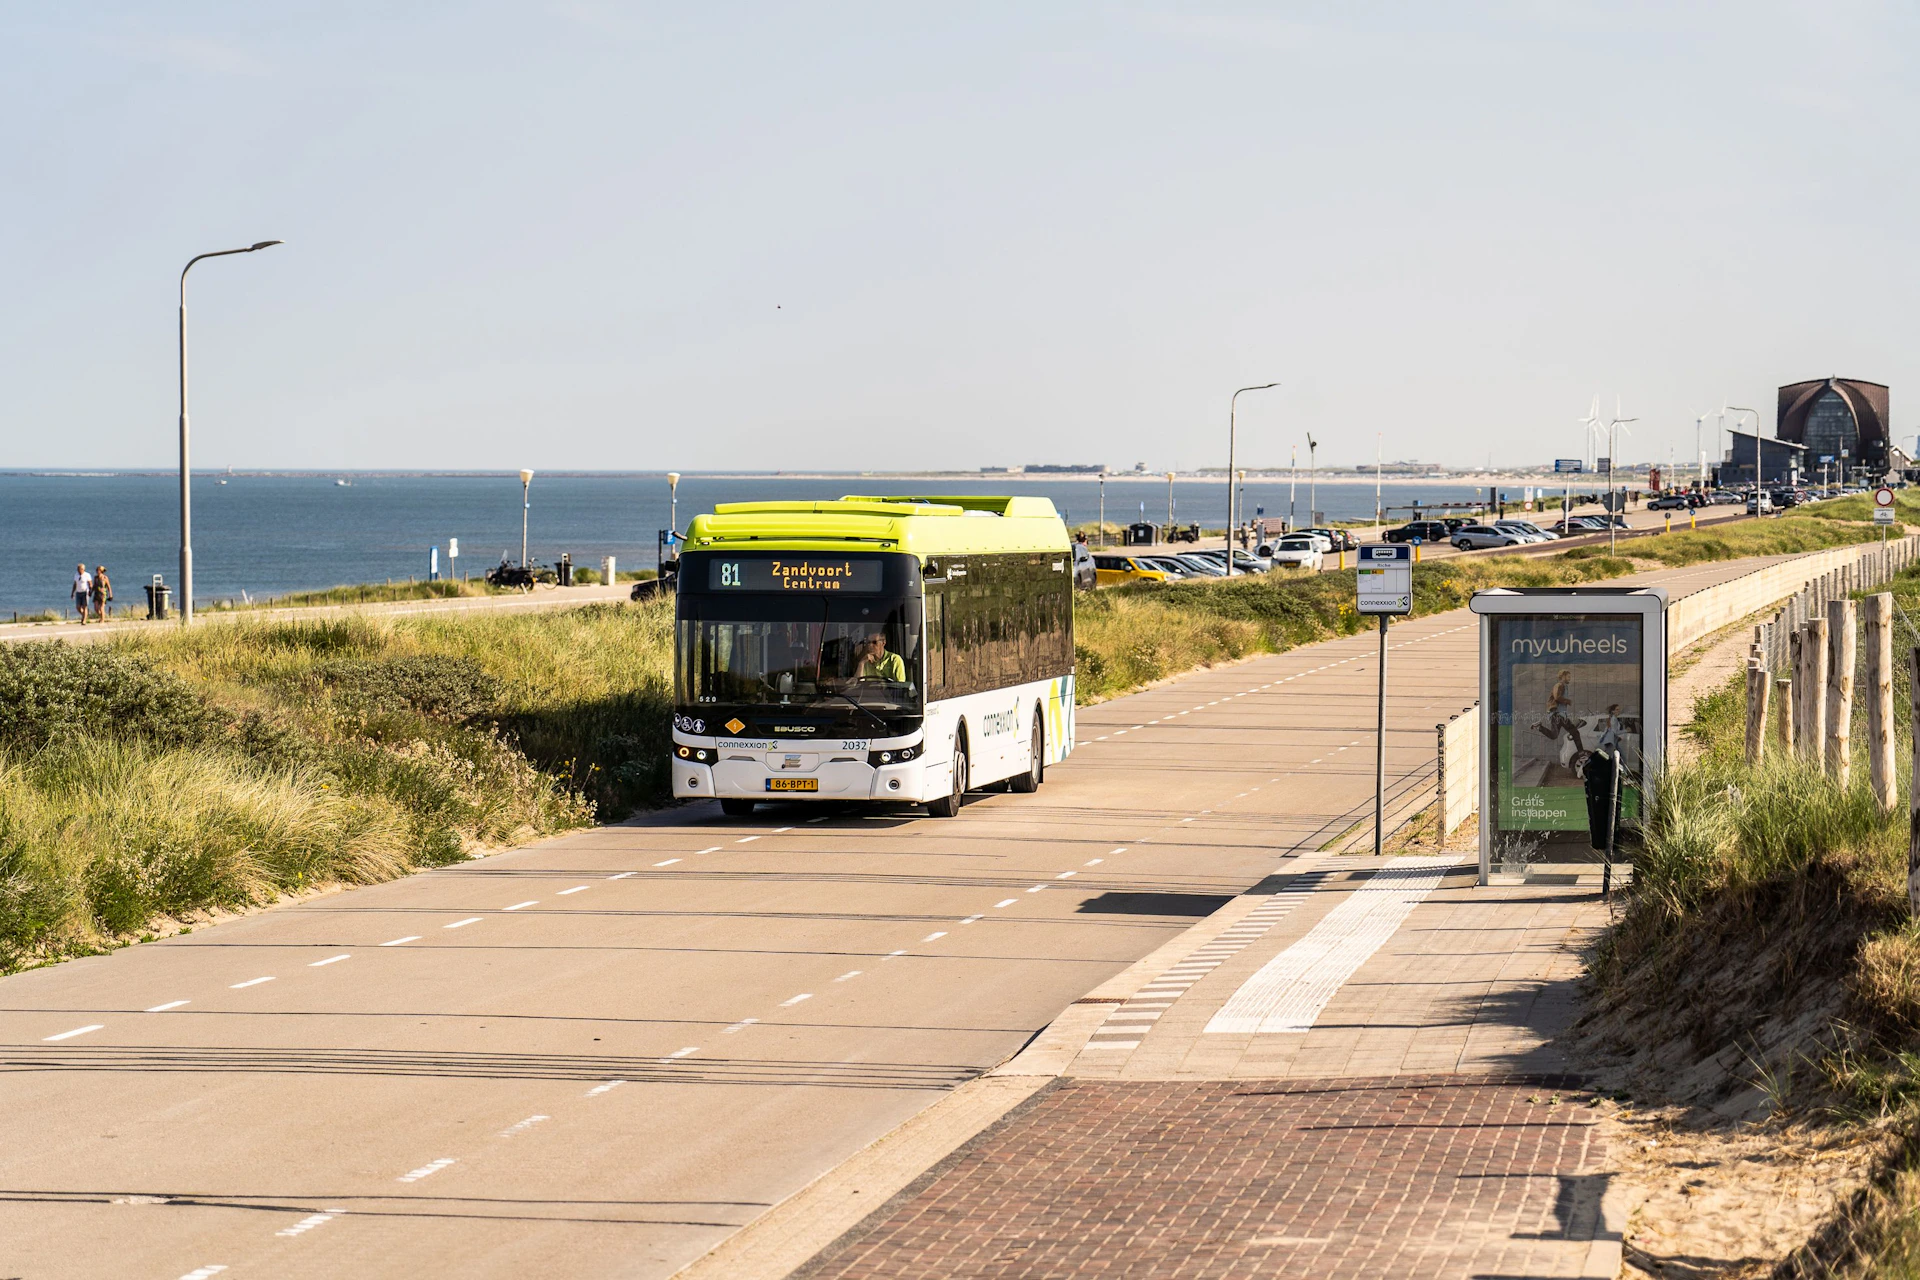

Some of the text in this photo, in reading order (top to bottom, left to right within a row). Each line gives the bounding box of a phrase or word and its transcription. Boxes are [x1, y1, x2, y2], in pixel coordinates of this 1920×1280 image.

[721, 563, 741, 586] 81
[772, 561, 852, 577] Zandvoort
[783, 577, 840, 589] Centrum
[1511, 634, 1628, 658] mywheels
[982, 709, 1014, 738] connexxion
[718, 741, 768, 749] connexxion
[842, 741, 867, 750] 2032
[775, 780, 814, 789] 86-BPT-1
[1511, 796, 1545, 807] Gratis
[1511, 806, 1567, 819] instappen
